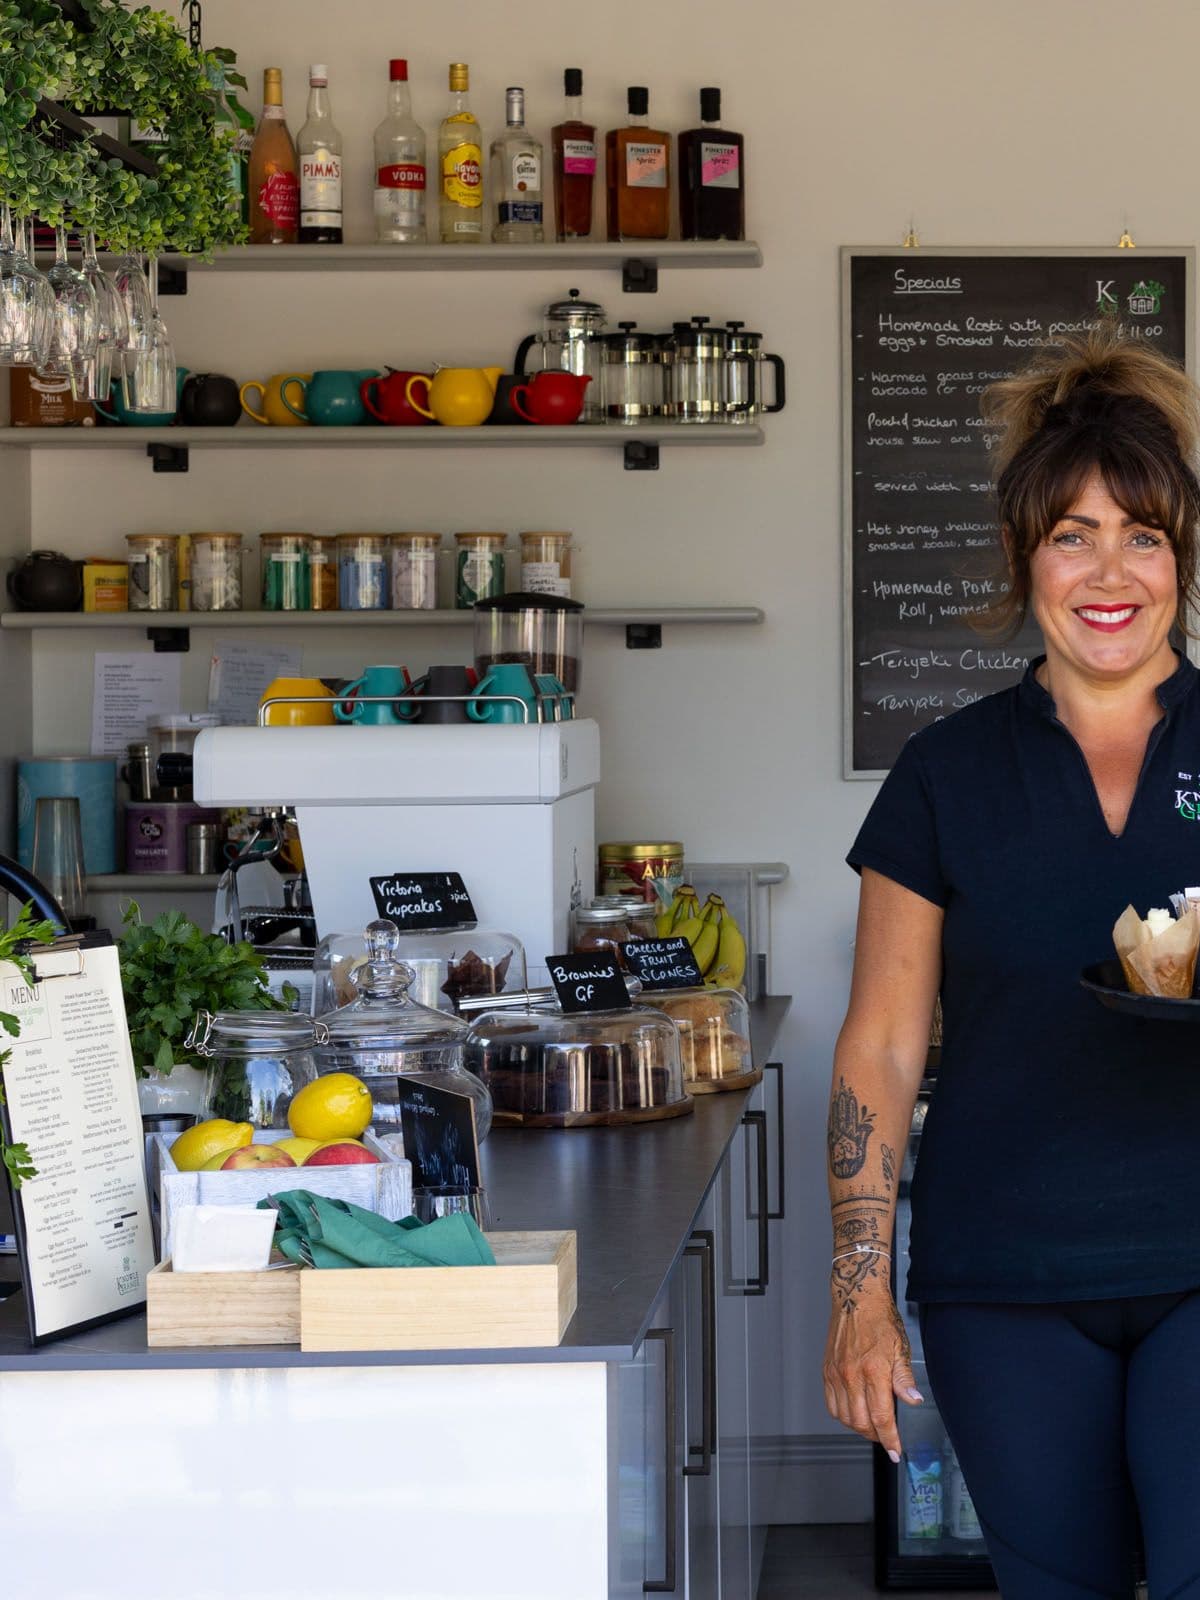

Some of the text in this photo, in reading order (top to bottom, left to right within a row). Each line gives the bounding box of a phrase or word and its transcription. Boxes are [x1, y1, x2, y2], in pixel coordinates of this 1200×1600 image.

[303, 161, 340, 178] PIMM'S
[392, 171, 425, 182] VODKA
[460, 172, 480, 183] Club
[894, 268, 962, 290] Specials
[1095, 279, 1118, 303] K
[879, 313, 960, 334] Homemade
[1009, 318, 1043, 332] with
[878, 337, 917, 353] eggs
[936, 335, 994, 347] Smashed
[871, 371, 928, 383] Warmed
[872, 386, 929, 397] avocado
[950, 435, 973, 444] and
[874, 482, 919, 493] served
[867, 521, 941, 540] Hot honey
[873, 580, 953, 600] Homemade
[961, 579, 994, 598] Pork
[899, 601, 933, 625] Roll,
[871, 649, 1030, 679] Teriyaki Chicken
[876, 693, 945, 716] Teriyaki
[377, 880, 423, 897] Victoria
[386, 897, 443, 919] Cupcakes
[625, 938, 686, 957] Cheese and
[640, 952, 678, 968] FRUIT
[553, 965, 615, 984] Brownies
[639, 965, 697, 982] SCONES
[10, 984, 41, 1006] MENU
[575, 984, 595, 1003] GF
[911, 1483, 936, 1495] VITA
